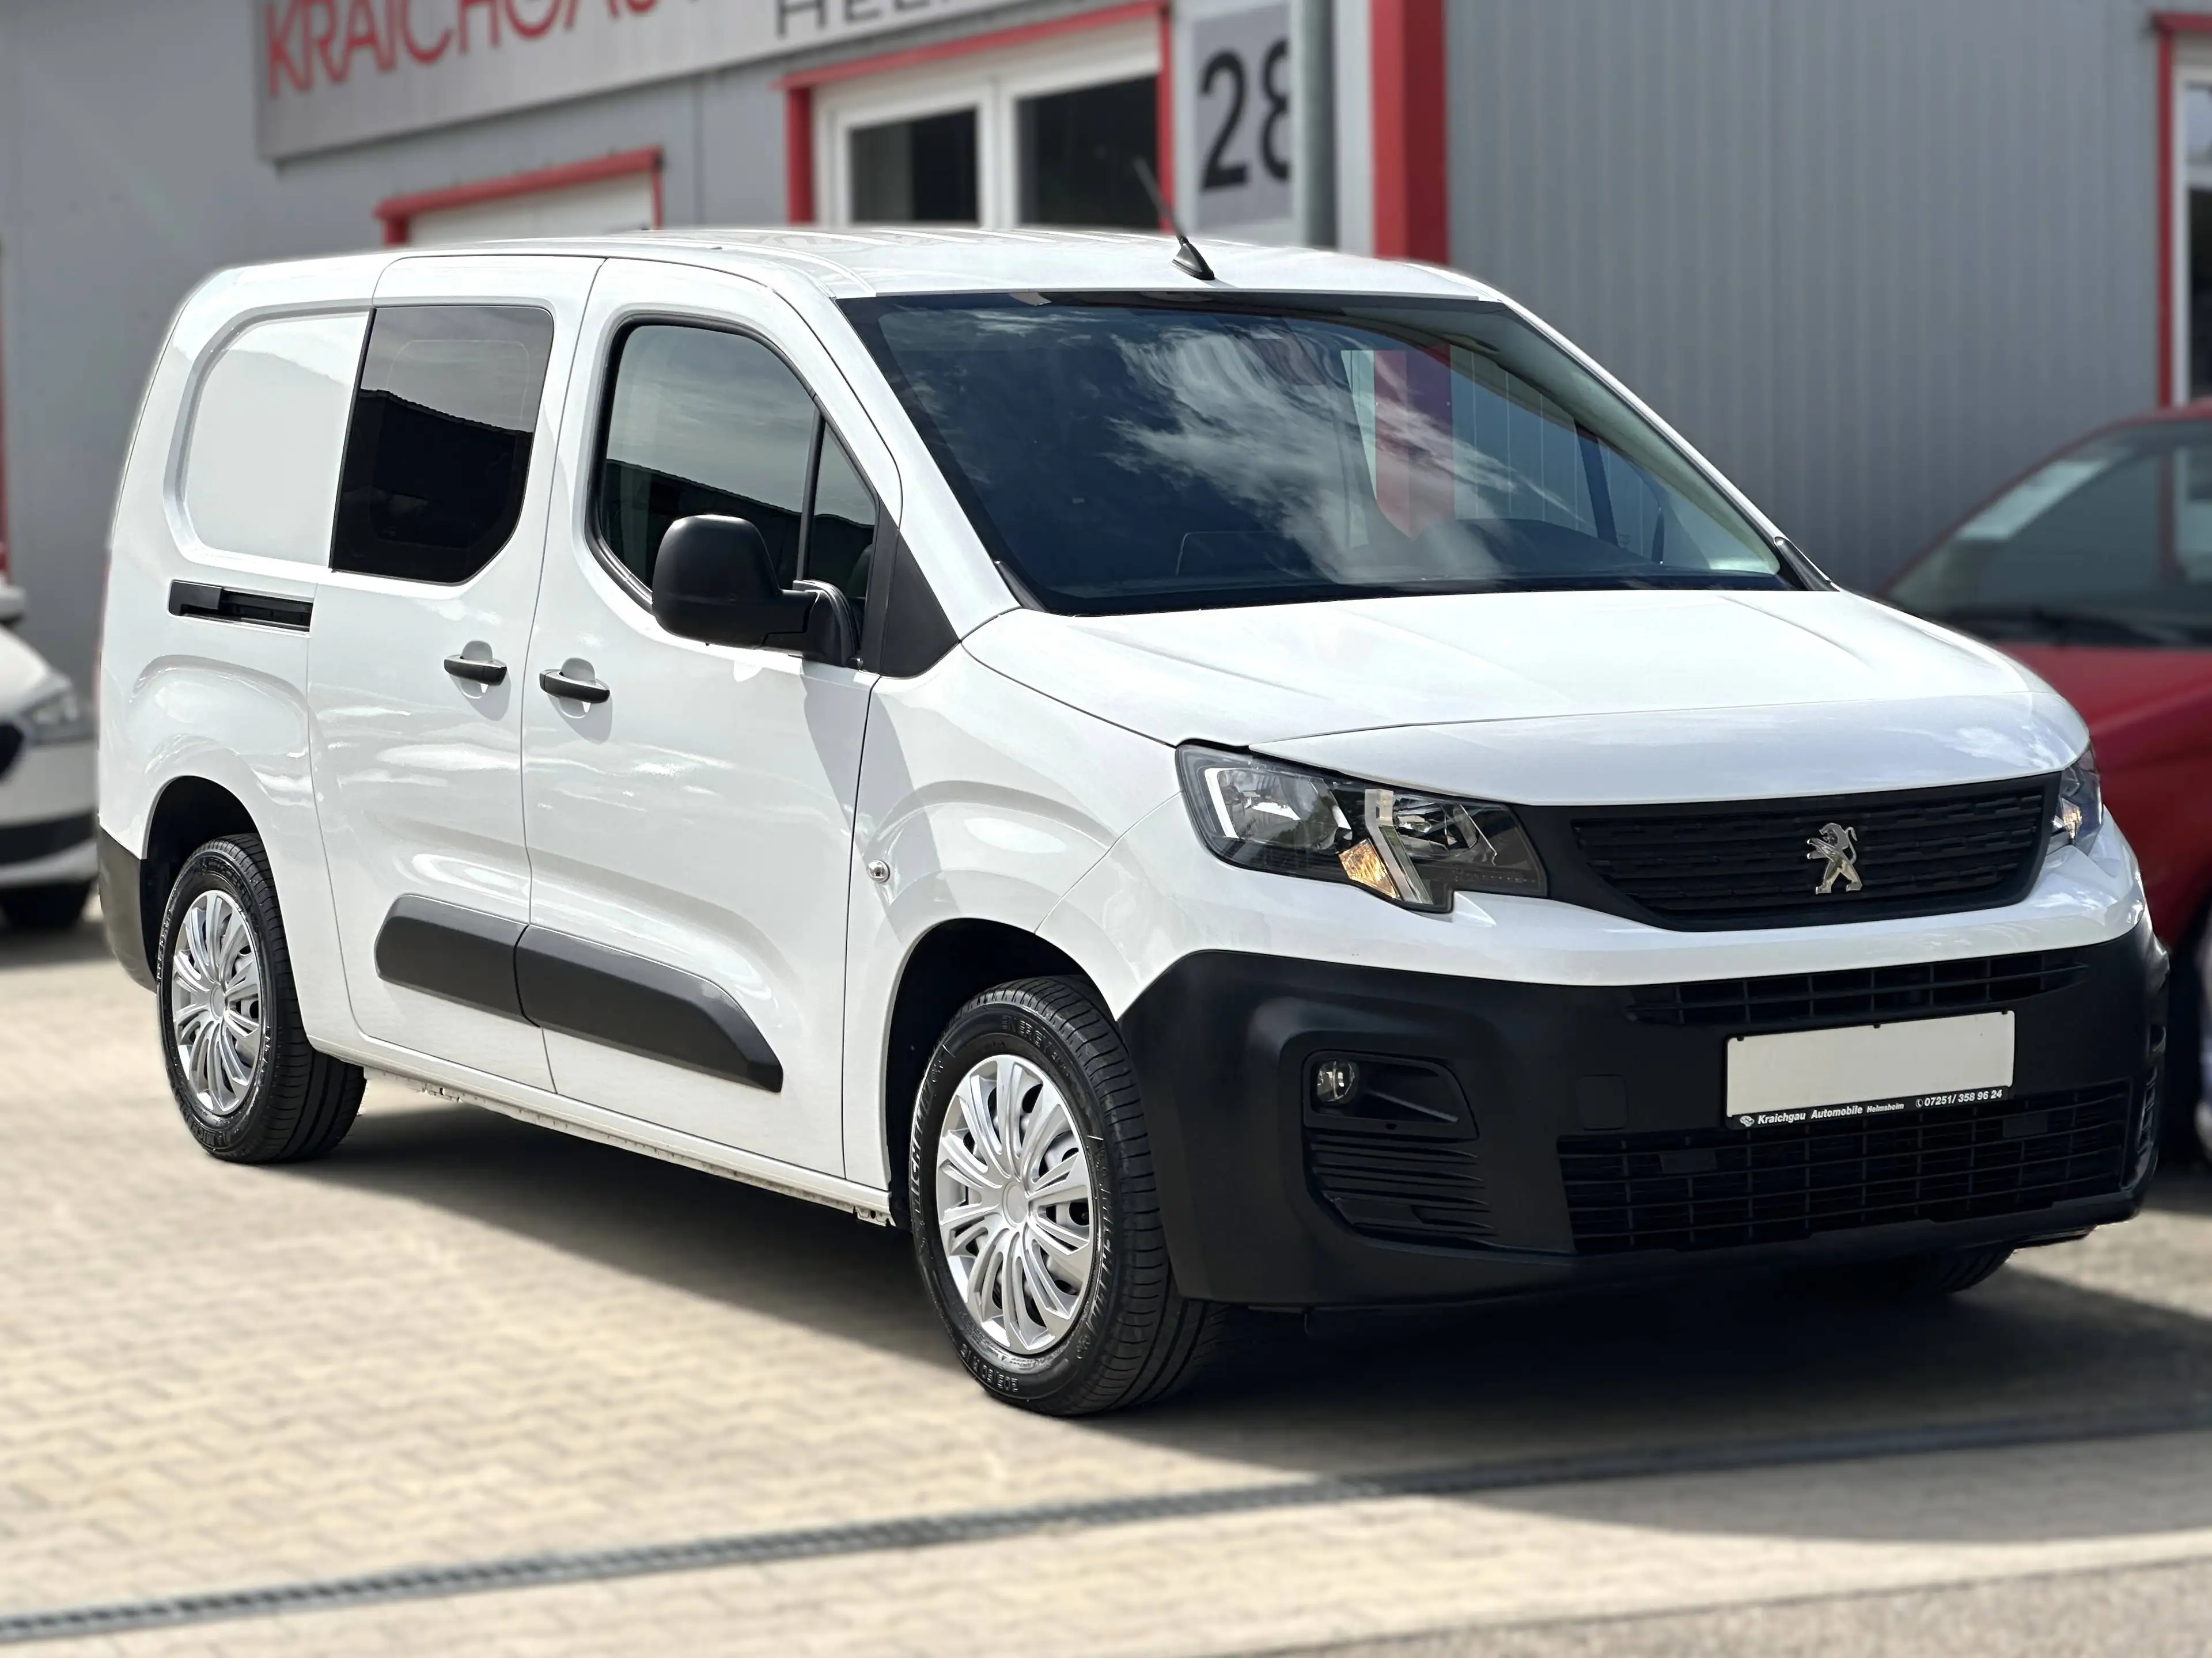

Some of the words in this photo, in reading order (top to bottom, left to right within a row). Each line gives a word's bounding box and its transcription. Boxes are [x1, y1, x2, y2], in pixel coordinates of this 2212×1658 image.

[265, 0, 658, 99] KRAICH
[1758, 1113, 1806, 1125] Kraichgau
[1810, 1105, 1863, 1120] Automobile
[1924, 1094, 1956, 1107] 07251/
[1958, 1092, 1975, 1103] 358
[1977, 1091, 1988, 1101] 96
[1990, 1089, 2002, 1099] 24
